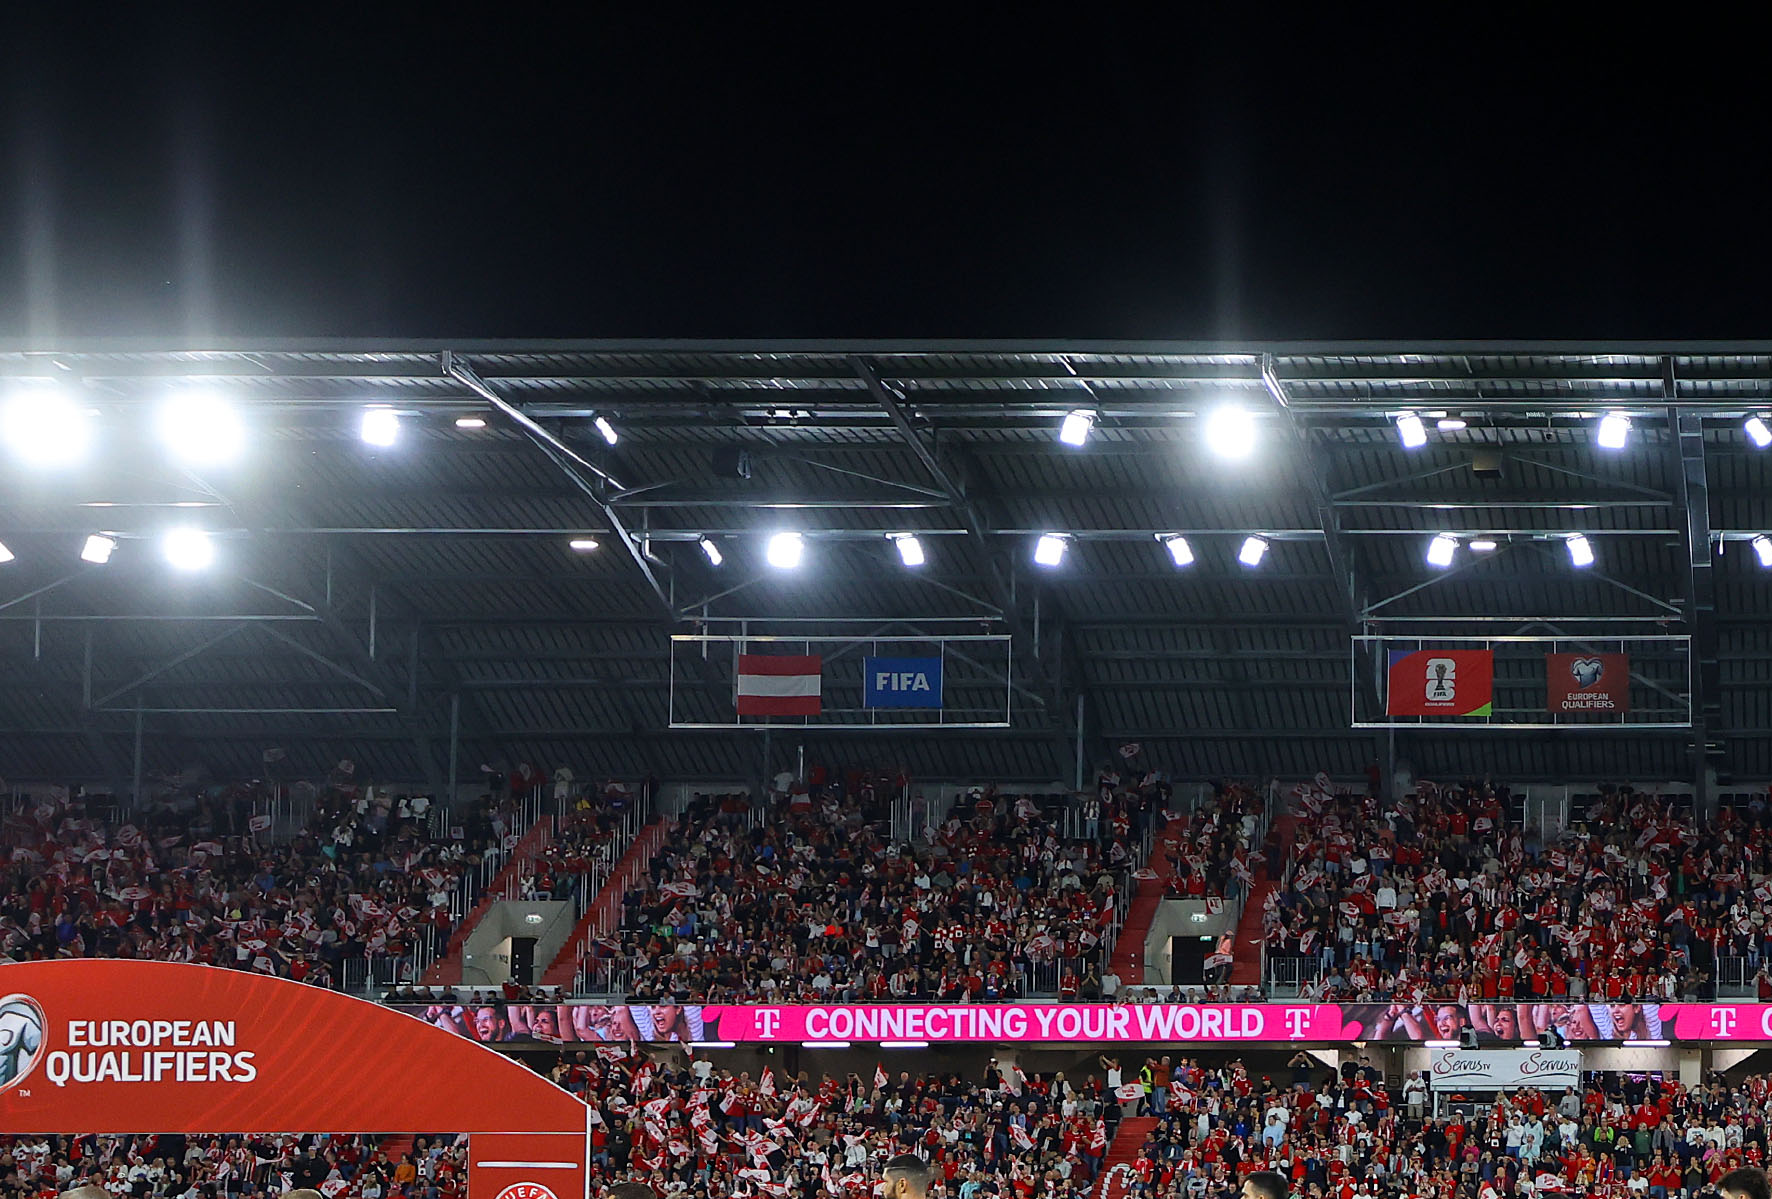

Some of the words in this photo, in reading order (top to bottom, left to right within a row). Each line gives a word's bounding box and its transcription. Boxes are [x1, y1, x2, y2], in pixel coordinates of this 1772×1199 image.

[876, 673, 930, 691] FIFA
[1561, 700, 1615, 710] QUALIFIERS
[1567, 693, 1609, 701] EUROPEAN
[68, 1020, 235, 1046] EUROPEAN
[755, 1009, 780, 1038] T
[805, 1008, 1027, 1038] CONNECTING
[1034, 1008, 1130, 1038] YOUR
[1136, 1005, 1264, 1039] WORLD
[1285, 1009, 1310, 1038] T
[1711, 1008, 1736, 1036] T
[46, 1051, 257, 1087] QUALIFIERS
